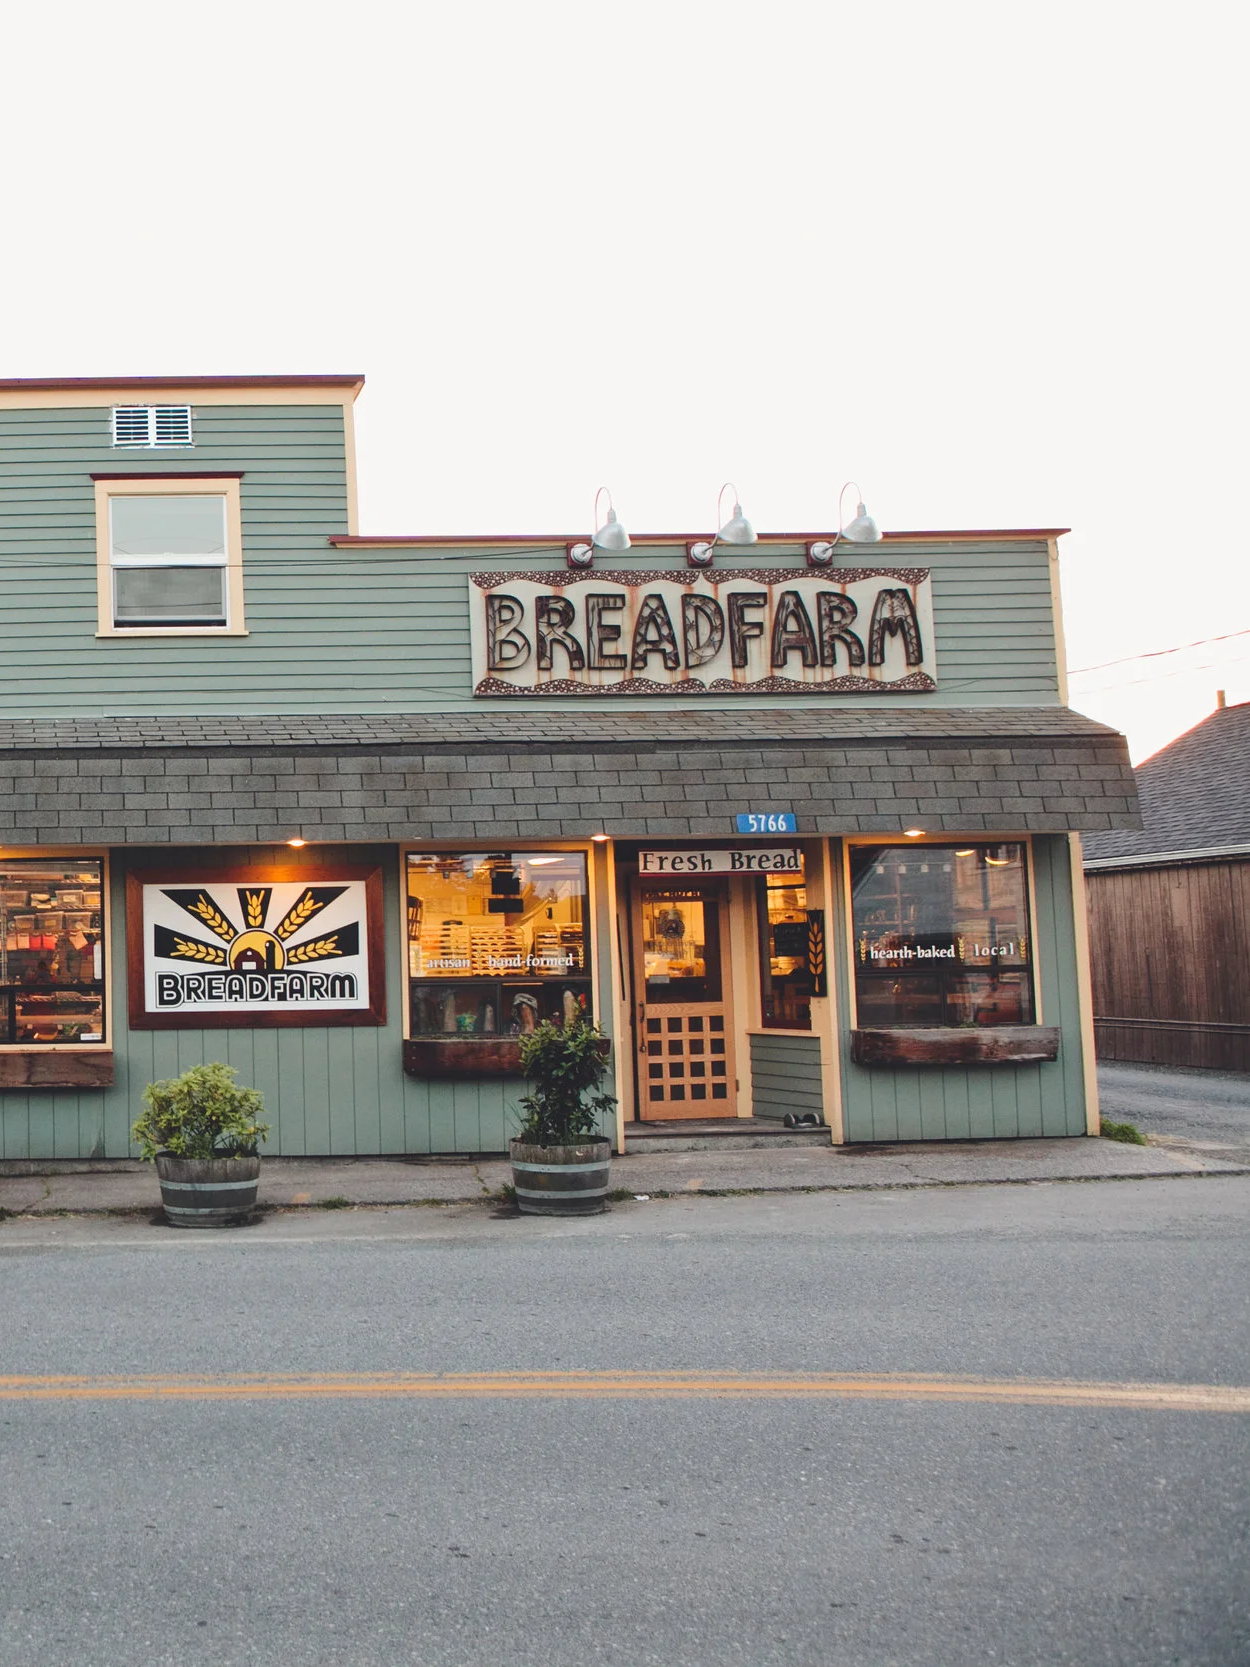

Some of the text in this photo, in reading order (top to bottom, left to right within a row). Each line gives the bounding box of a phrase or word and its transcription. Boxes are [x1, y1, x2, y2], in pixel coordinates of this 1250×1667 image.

[485, 588, 923, 670] BREADFARM
[748, 814, 787, 832] 5766
[642, 849, 799, 872] Fresh Bread
[870, 942, 1014, 959] hearth-baked local
[426, 953, 574, 969] artisan hand-formed
[155, 971, 359, 1009] BREADFARM
